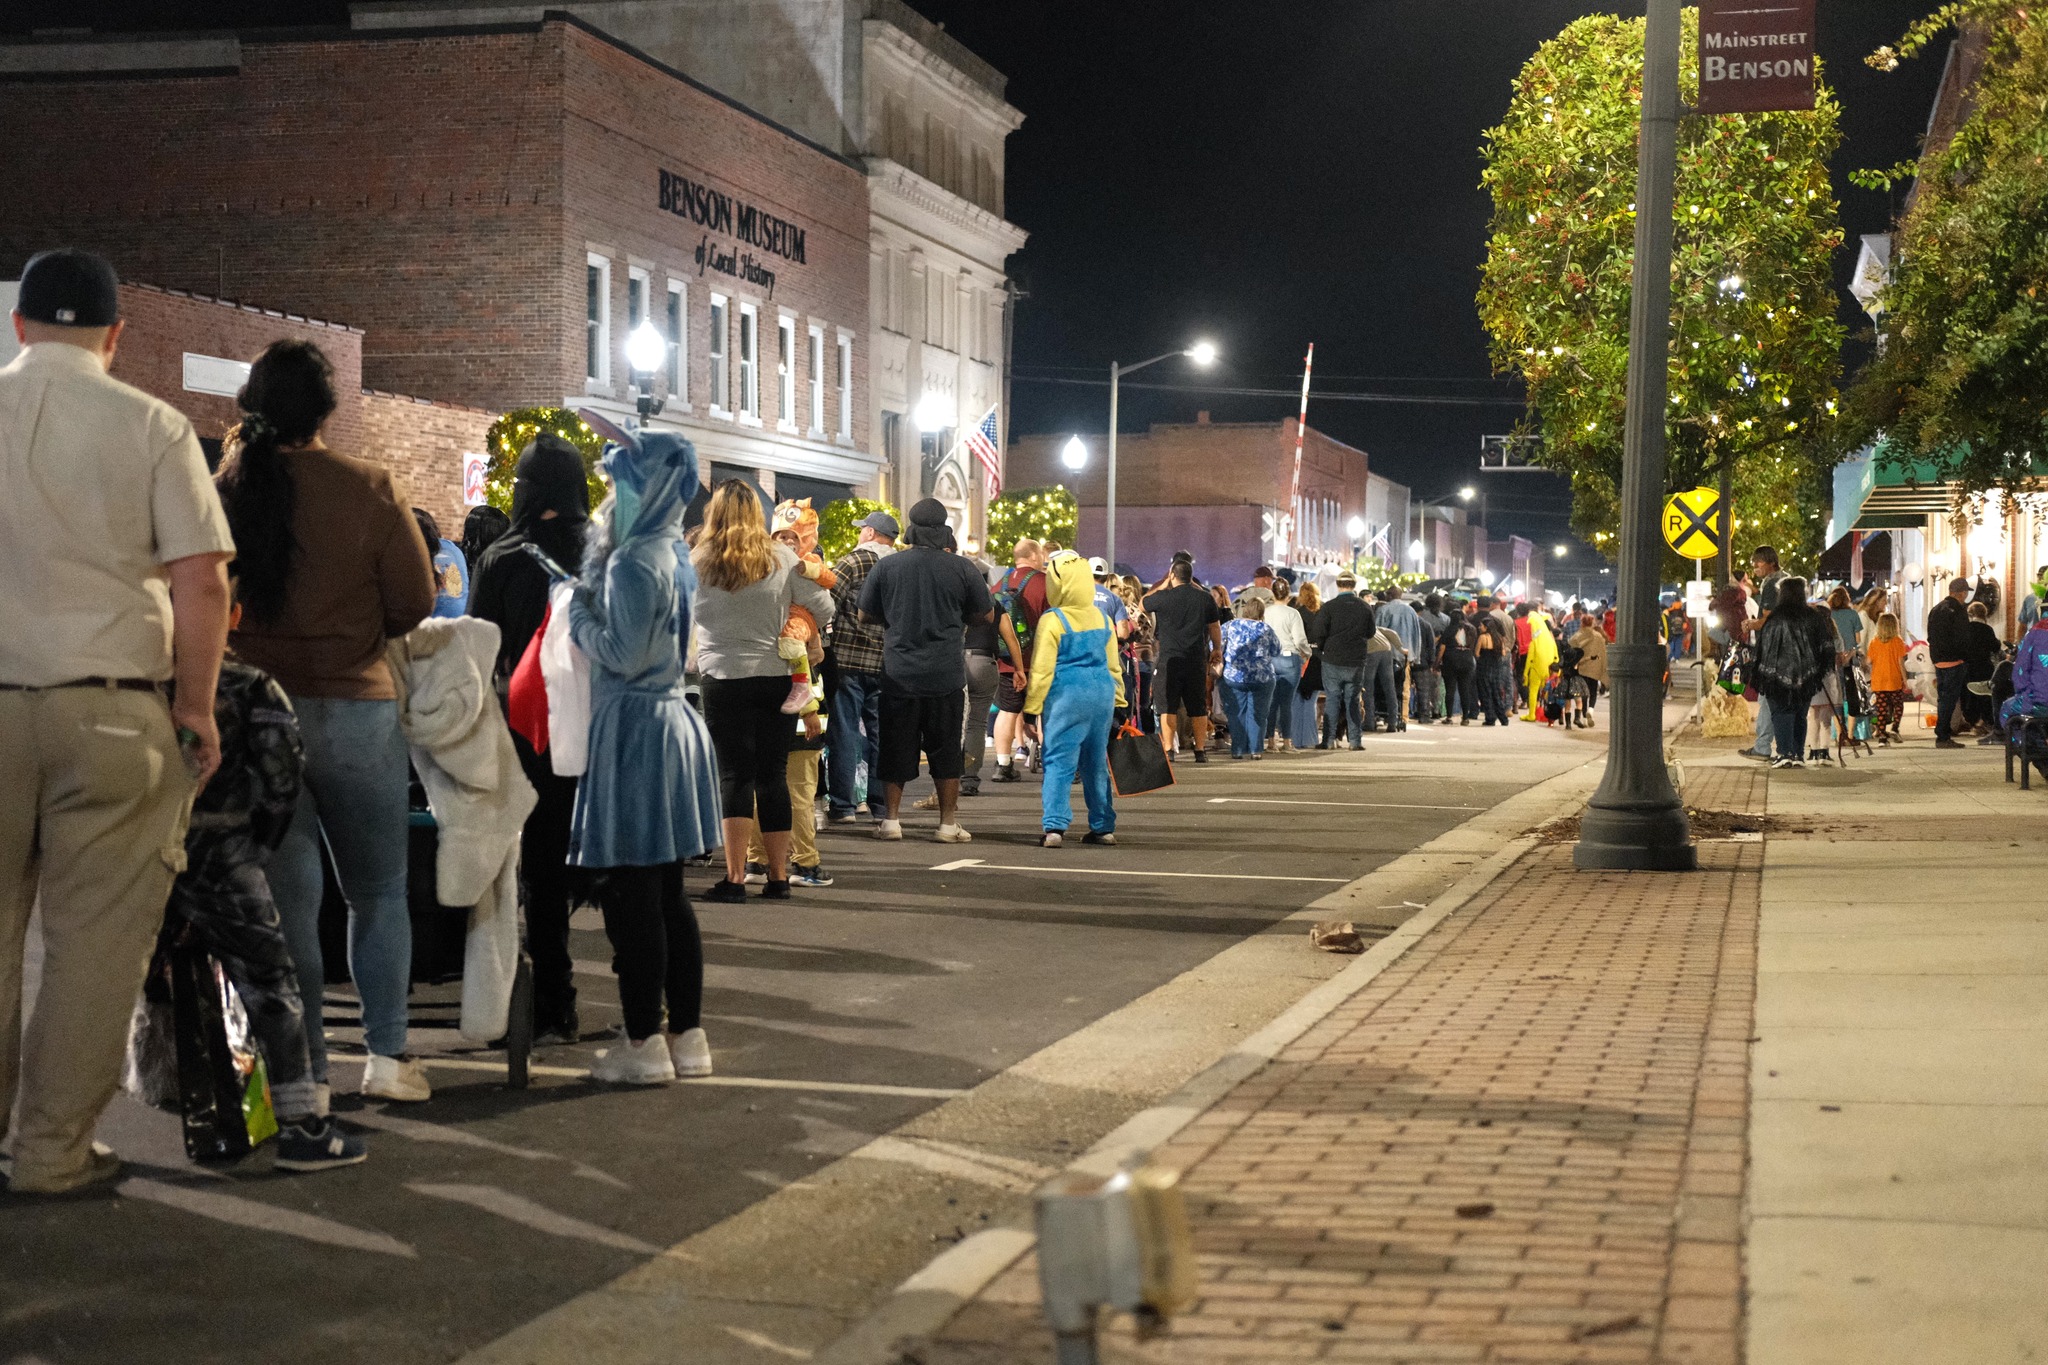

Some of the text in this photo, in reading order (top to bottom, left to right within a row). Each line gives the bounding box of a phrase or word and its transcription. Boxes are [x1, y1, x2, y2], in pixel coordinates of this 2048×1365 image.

[1705, 56, 1808, 81] BENSON
[658, 168, 806, 265] BENSON MUSEUM
[695, 235, 776, 301] of Local History
[1669, 515, 1682, 531] R
